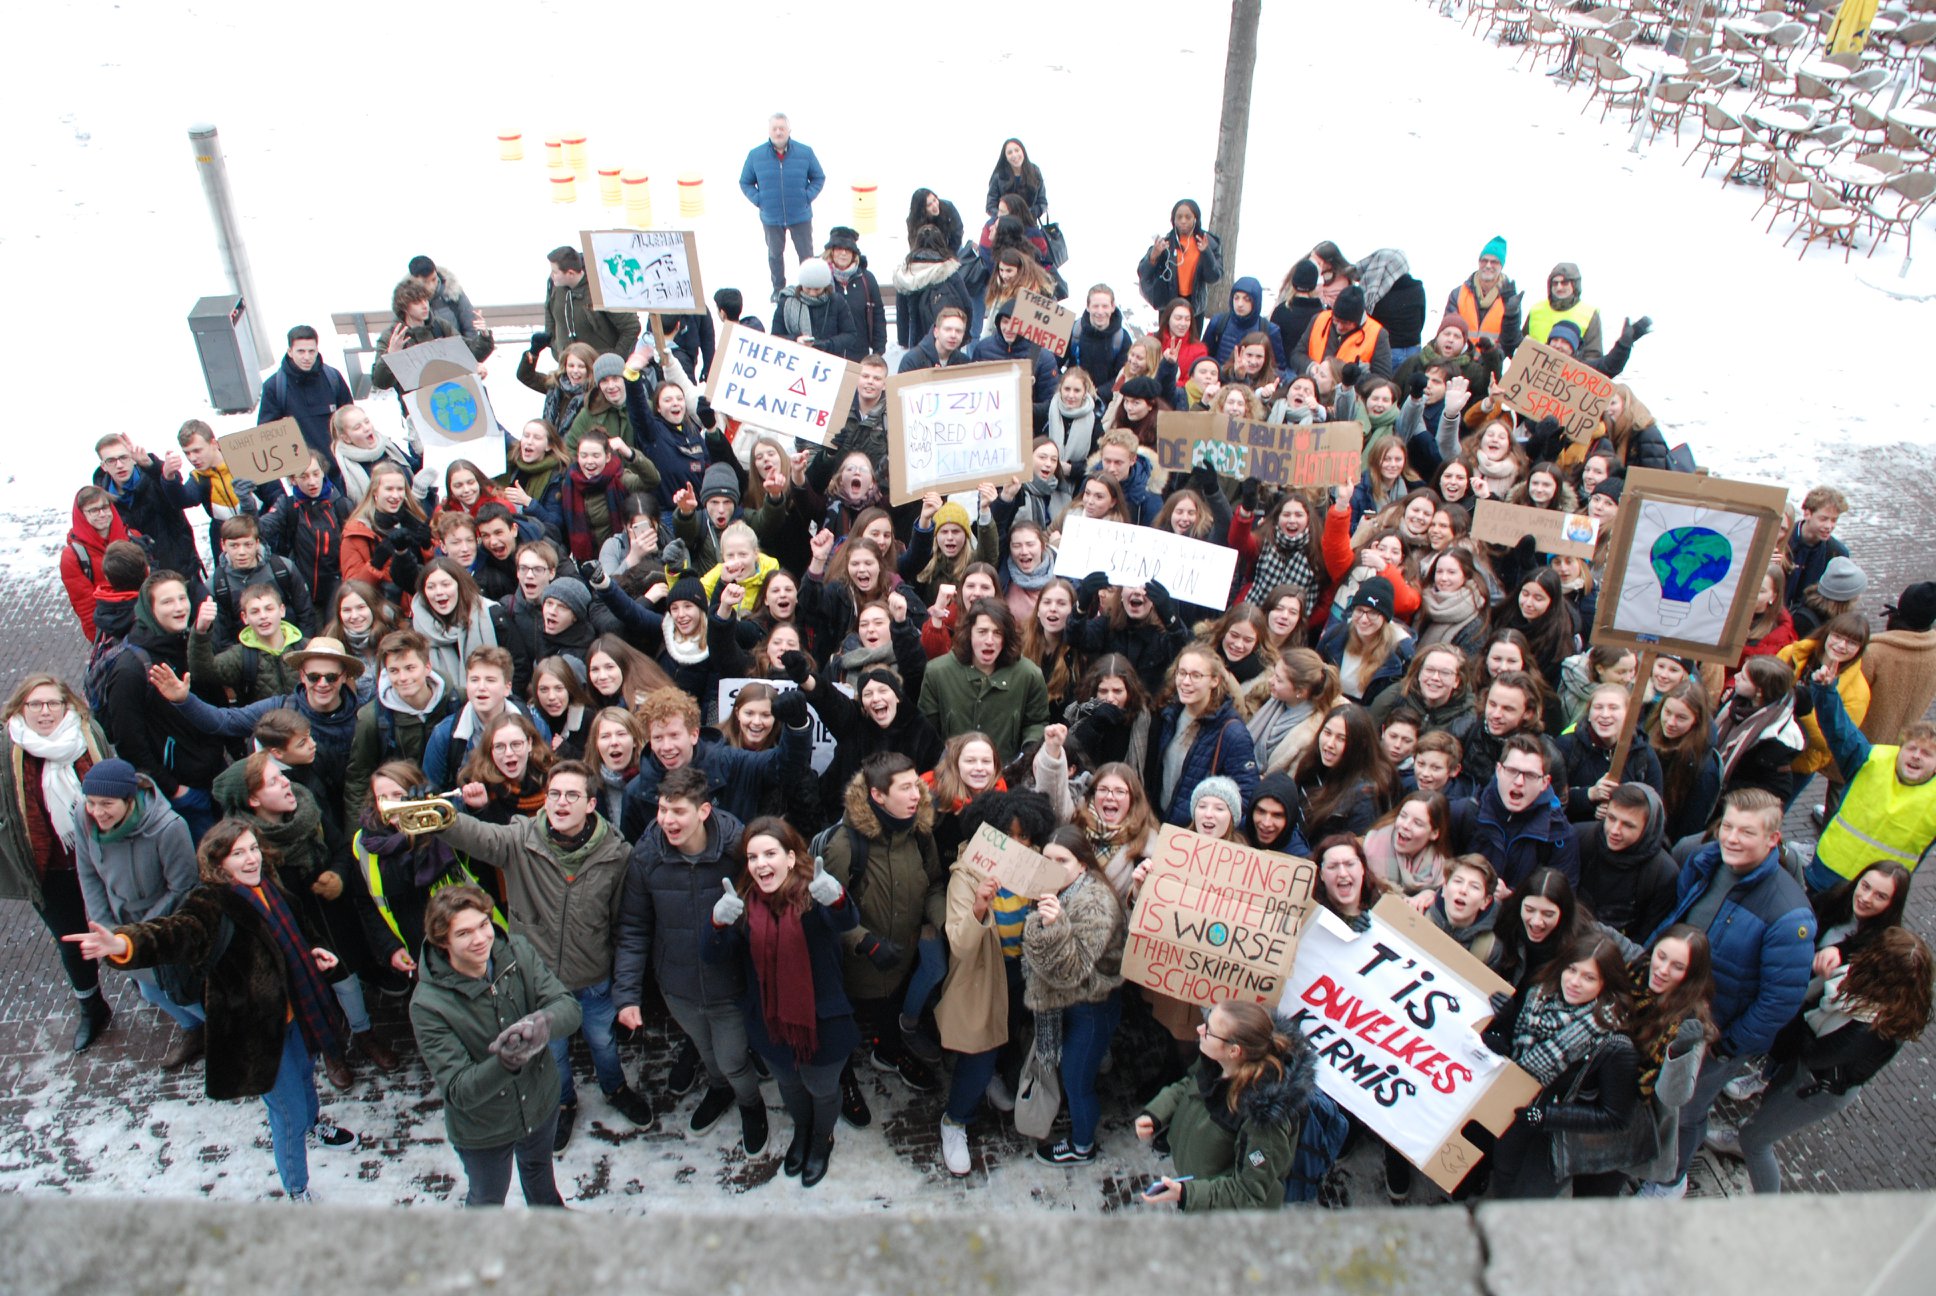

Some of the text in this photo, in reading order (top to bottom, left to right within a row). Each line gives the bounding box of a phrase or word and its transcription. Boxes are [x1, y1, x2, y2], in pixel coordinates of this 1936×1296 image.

[1024, 290, 1065, 317] THERE IS
[1034, 310, 1050, 325] NO
[1010, 316, 1066, 356] PLANET B
[738, 337, 800, 372] THERE
[731, 361, 757, 379] NO
[1532, 347, 1612, 397] THE WORLD
[909, 390, 1000, 418] WIJ ZIJN
[1519, 366, 1605, 417] NEEDS US
[228, 425, 287, 451] WHAT ABOUT
[934, 420, 1002, 442] RED ONS
[1226, 415, 1245, 442] IK
[1565, 412, 1594, 438] UP
[251, 445, 284, 472] US
[937, 448, 1007, 473] KLIMAAT
[1158, 437, 1187, 469] DE
[1249, 447, 1292, 485] NOG
[1293, 450, 1360, 486] HOTTER
[1172, 564, 1200, 595] ON
[981, 826, 1008, 851] COOL
[971, 851, 997, 873] HOT
[1154, 872, 1308, 937] CLIMATE PACT
[1130, 932, 1184, 966] THAN
[1174, 911, 1286, 965] WORSE
[1300, 974, 1473, 1094] DUVELKES
